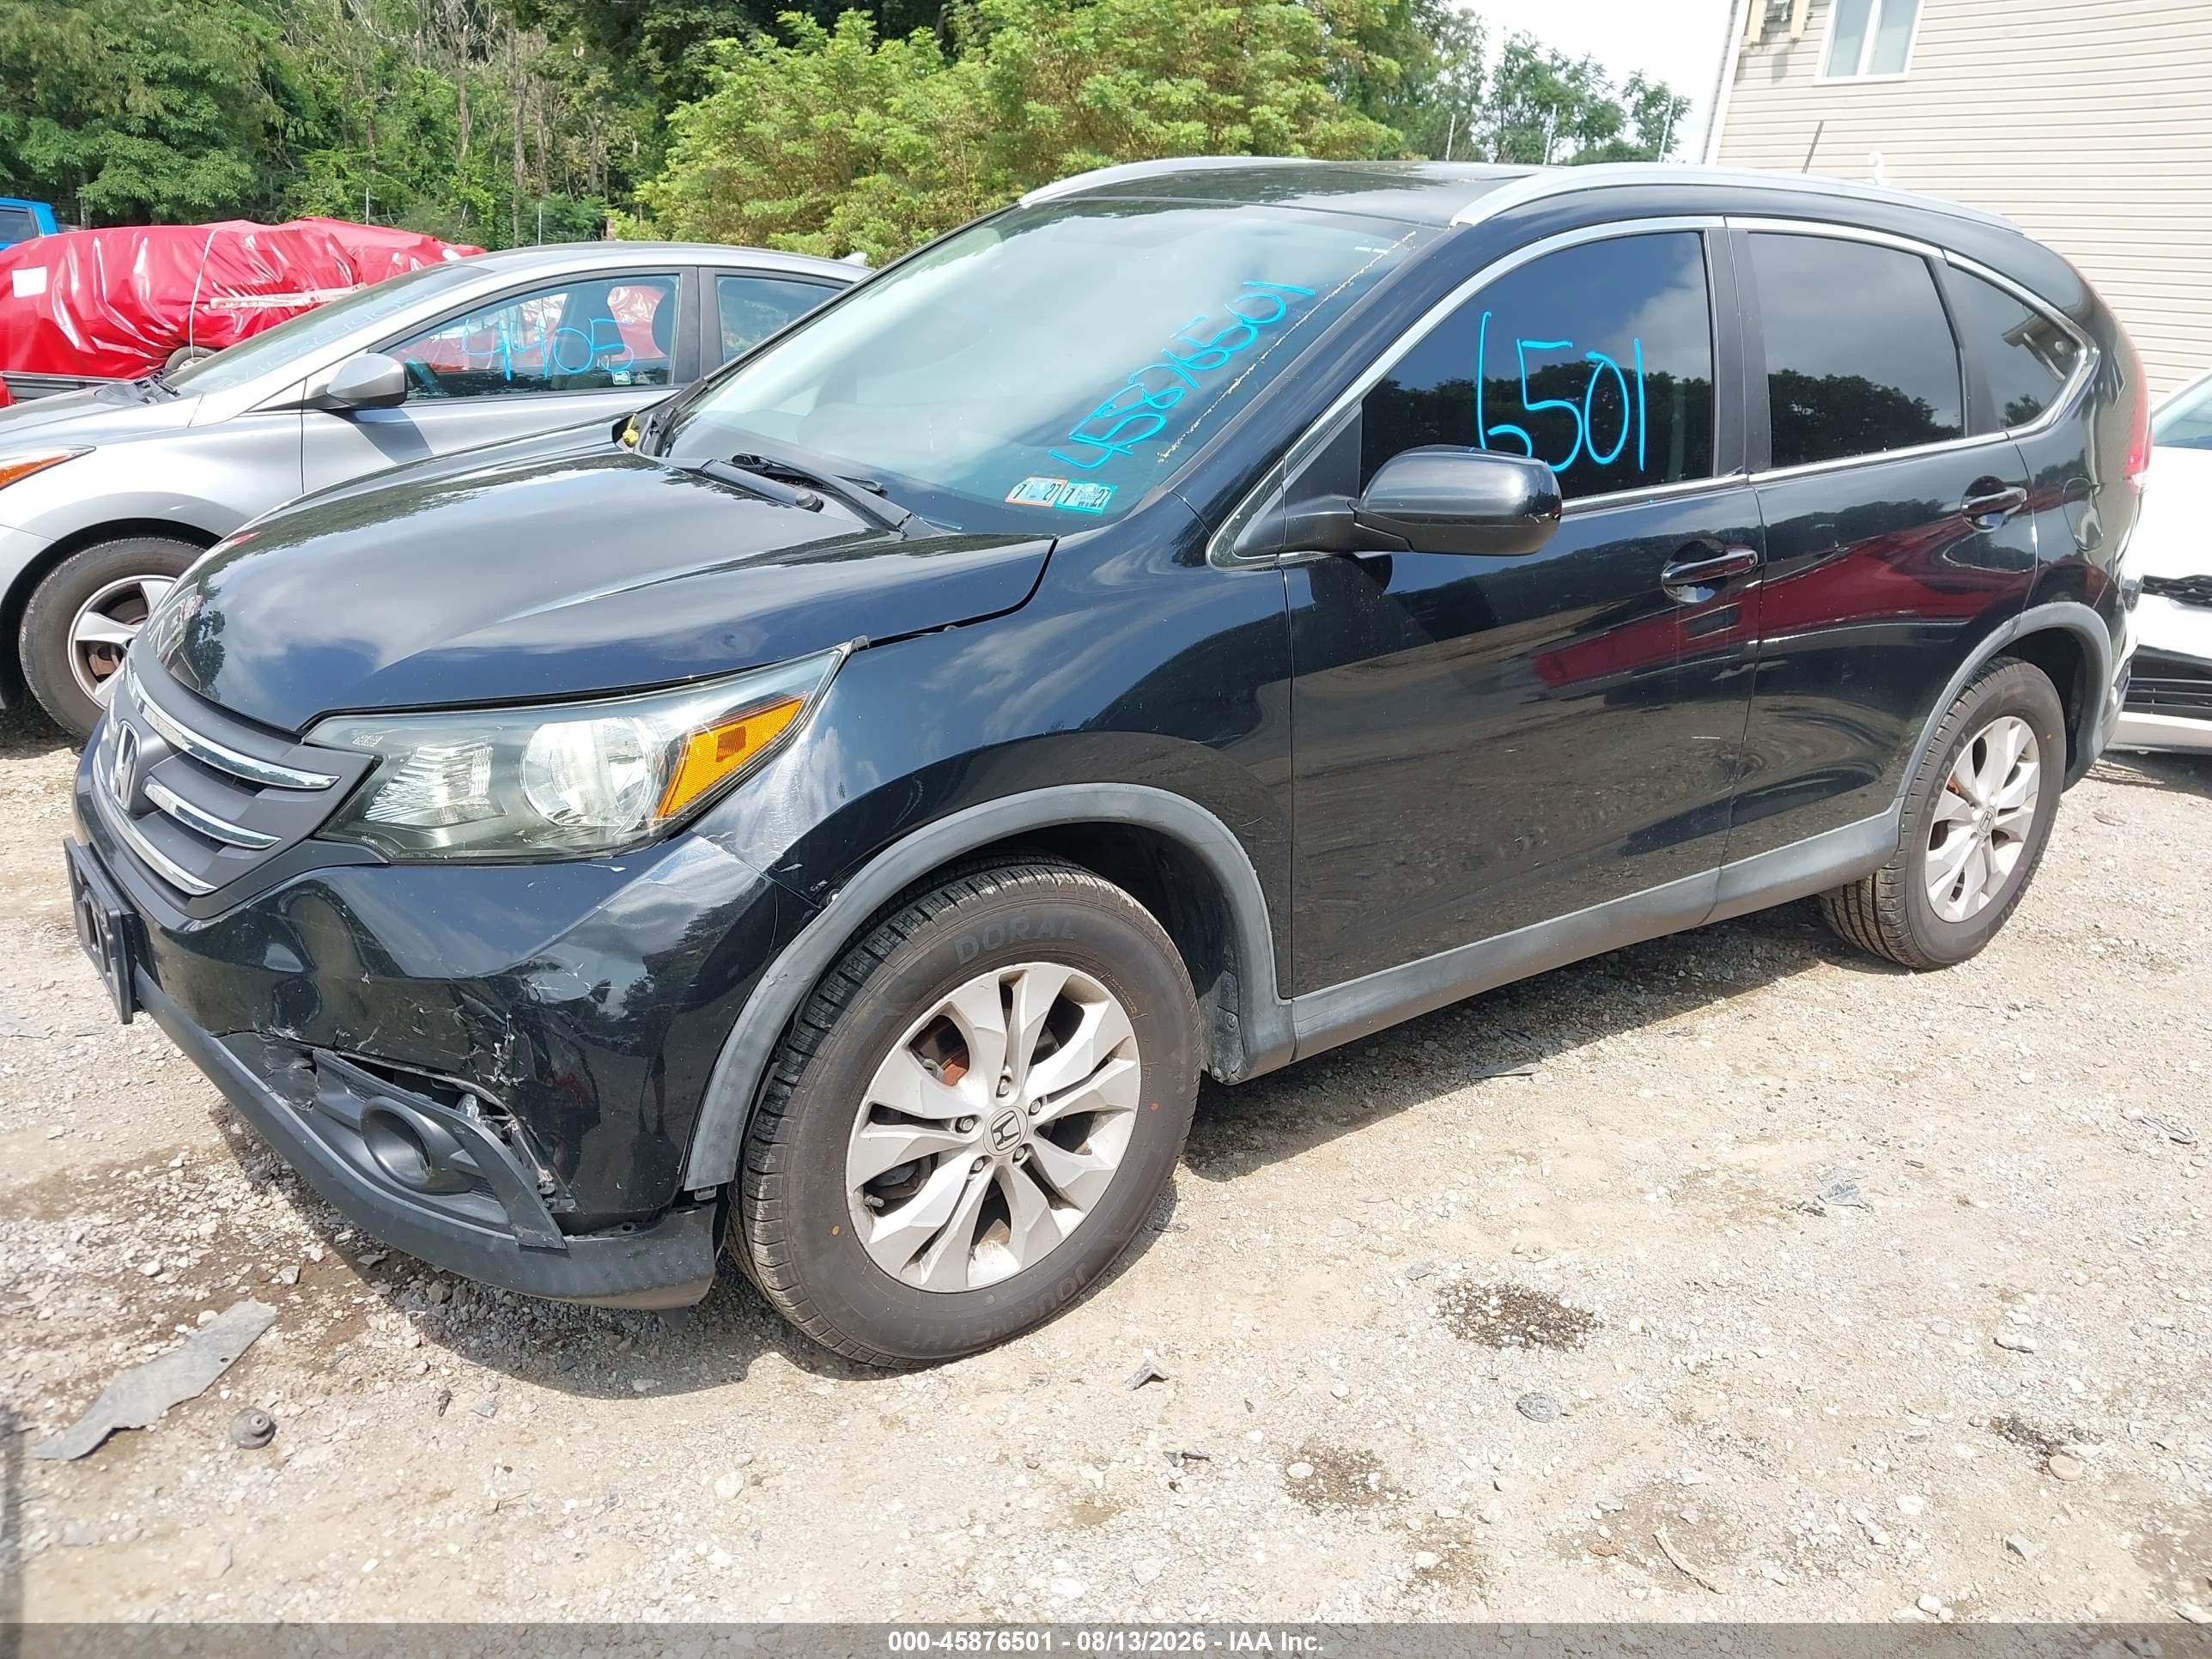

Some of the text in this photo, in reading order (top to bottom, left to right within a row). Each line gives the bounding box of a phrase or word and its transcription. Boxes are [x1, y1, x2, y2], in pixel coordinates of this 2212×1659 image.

[1048, 280, 1316, 469] 45876501
[1477, 310, 1646, 472] 6501
[955, 915, 1075, 964] DORAL
